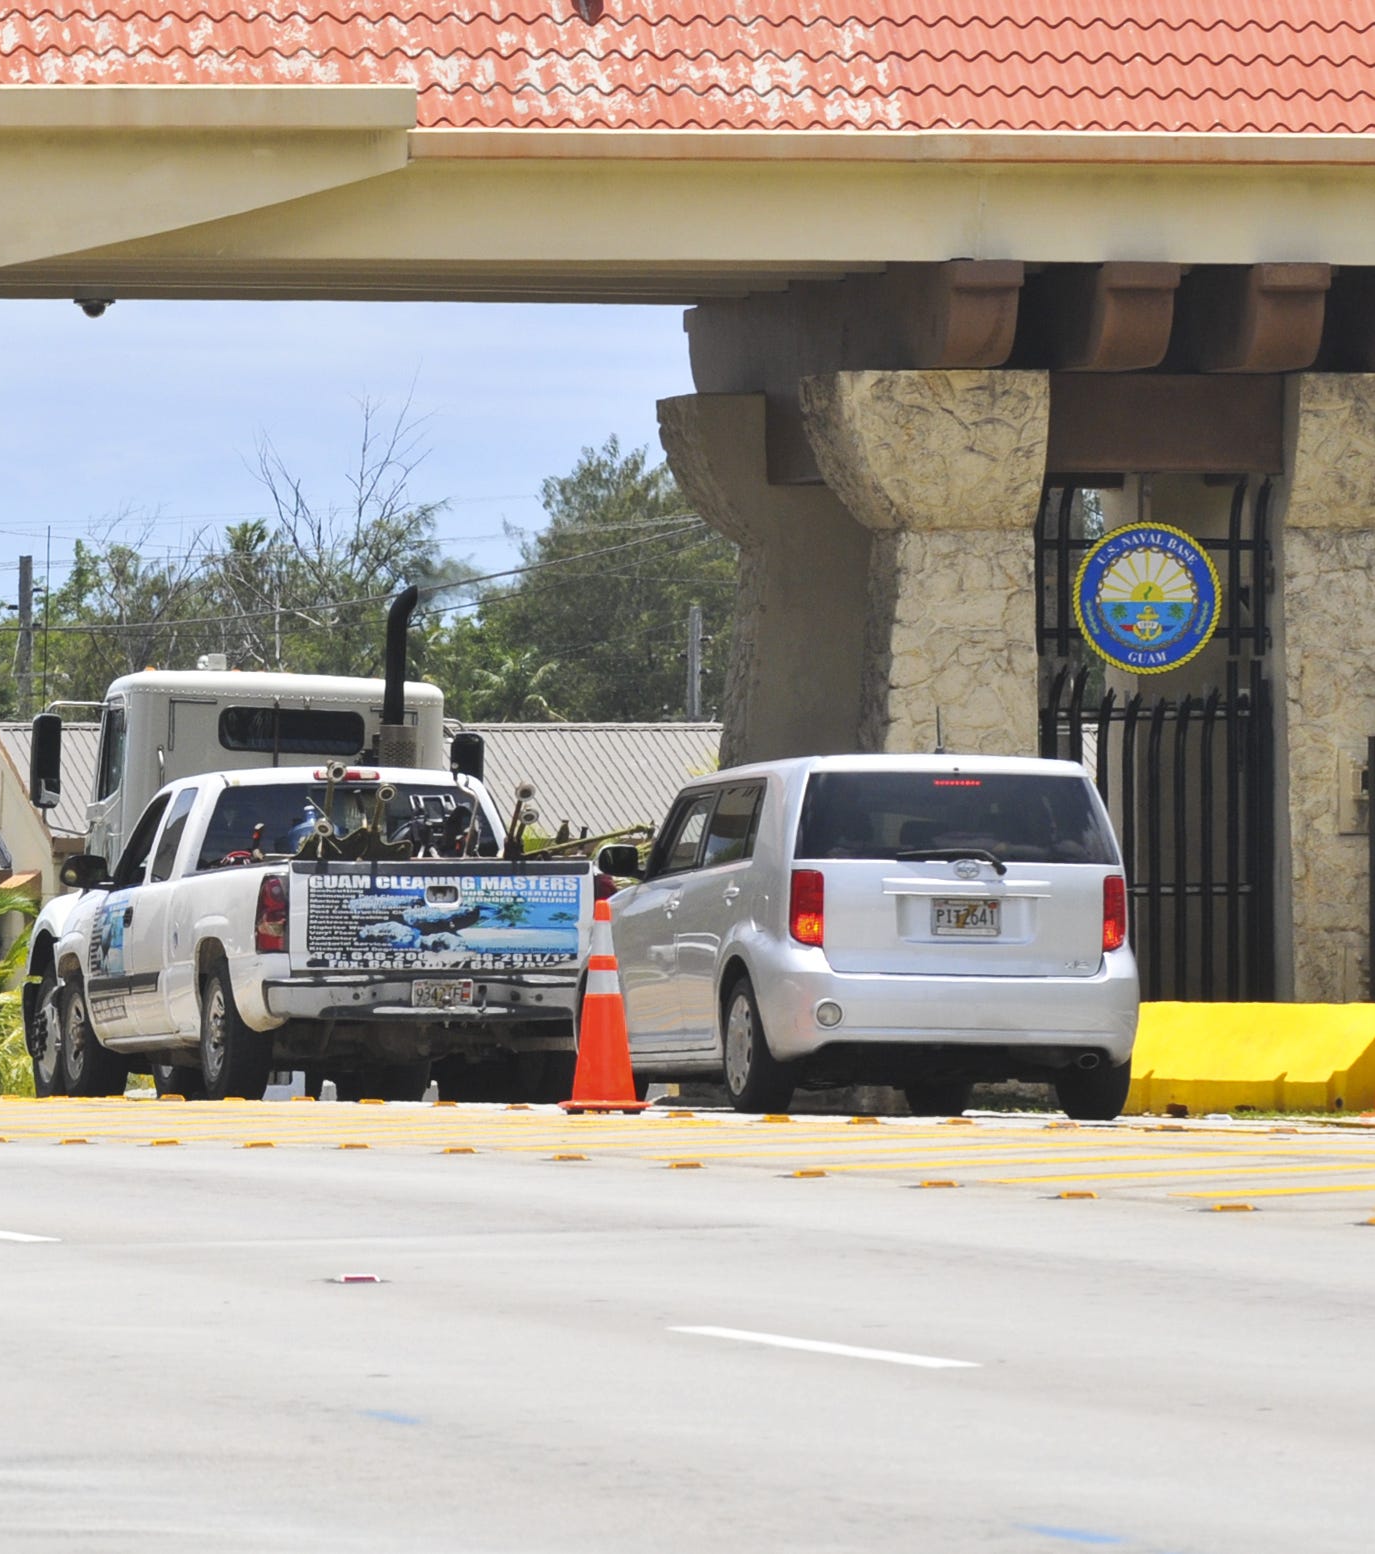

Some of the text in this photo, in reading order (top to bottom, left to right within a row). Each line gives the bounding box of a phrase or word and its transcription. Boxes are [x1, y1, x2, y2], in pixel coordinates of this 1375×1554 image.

[1096, 533, 1199, 565] U.S. NAVAL BASE
[1128, 651, 1167, 664] GUAM
[309, 875, 578, 891] GUAM CLEANING MASTERS
[313, 952, 347, 960] Tel:
